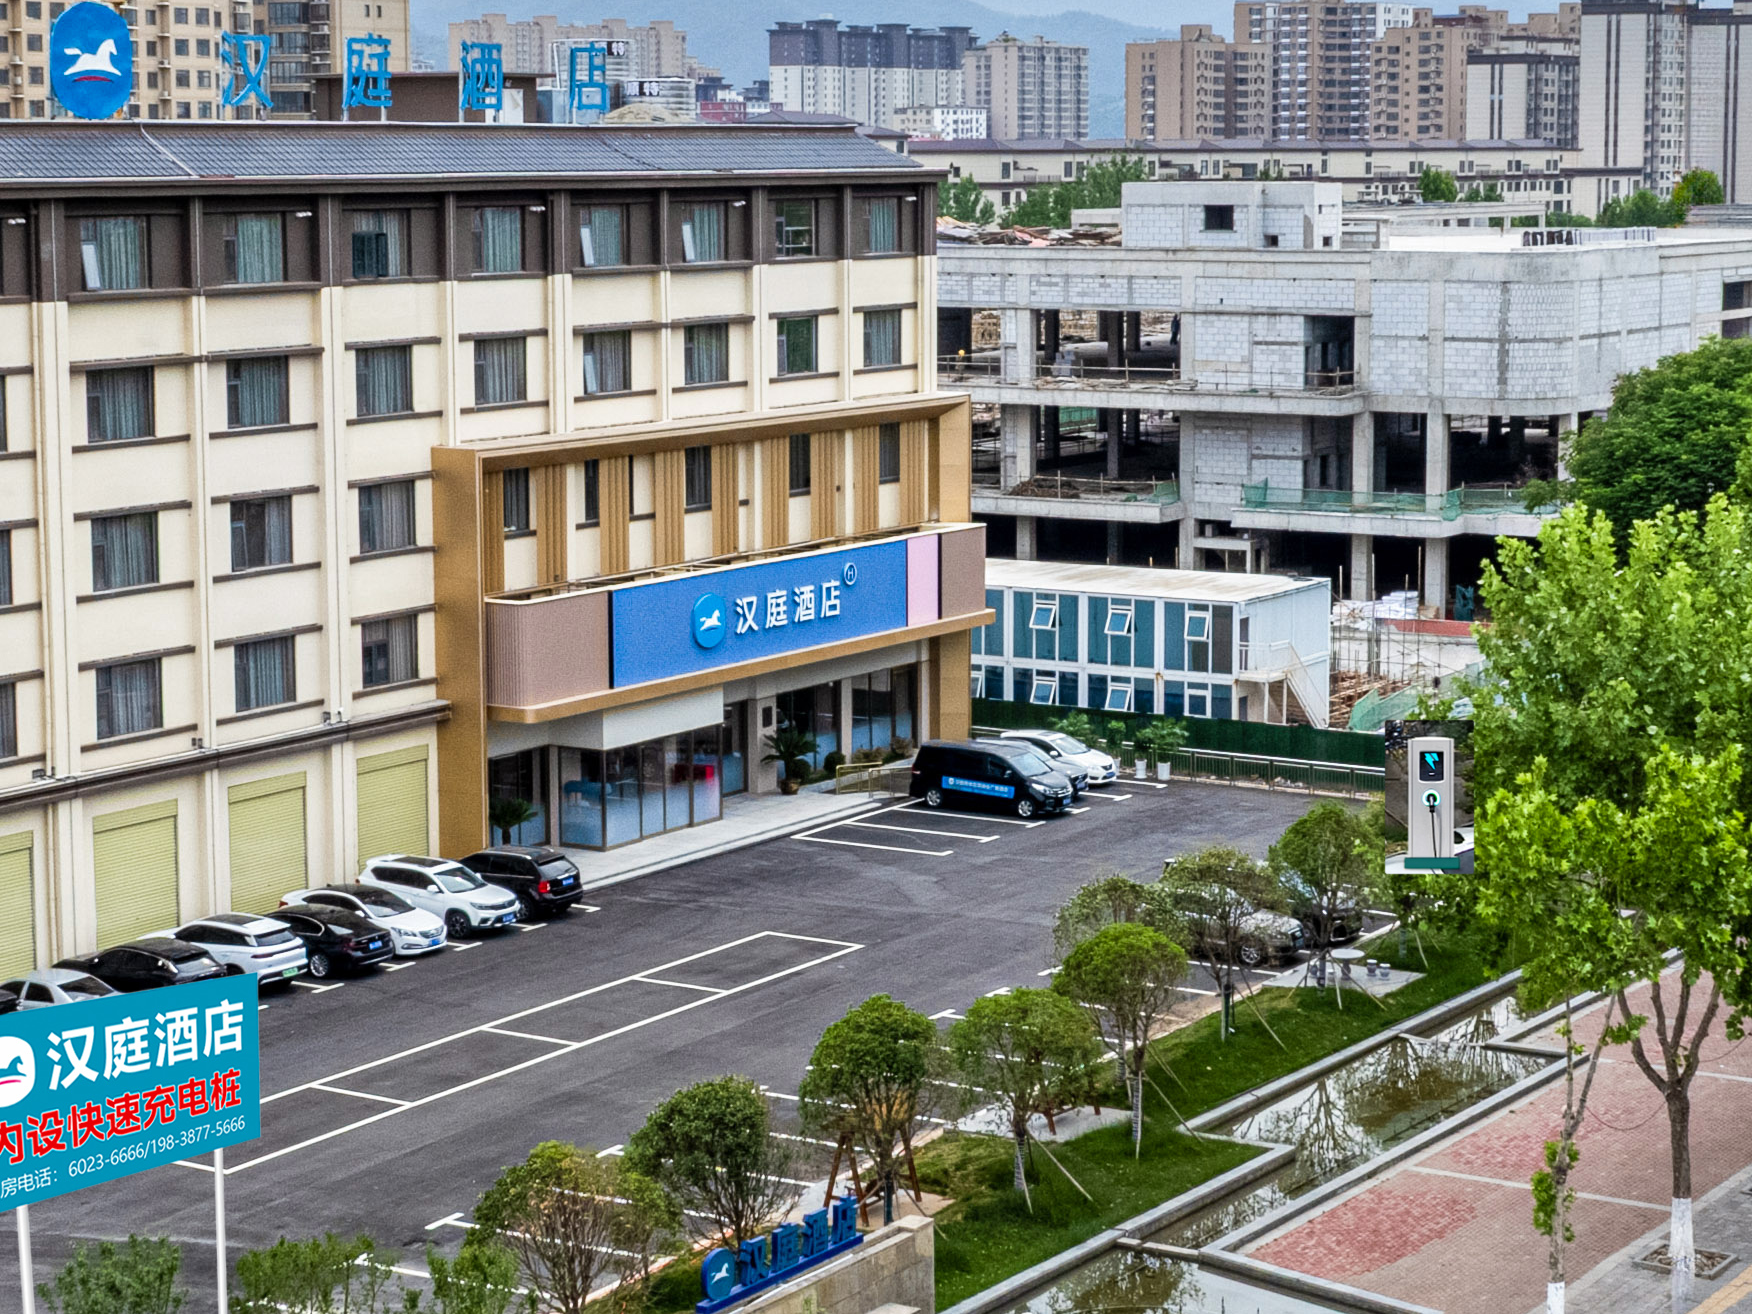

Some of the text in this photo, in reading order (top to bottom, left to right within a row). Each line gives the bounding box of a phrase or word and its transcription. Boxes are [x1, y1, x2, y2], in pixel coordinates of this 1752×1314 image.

[221, 30, 610, 111] 汉庭酒店
[734, 579, 841, 635] 汉庭酒店
[47, 999, 245, 1091] 汉庭酒店
[68, 1115, 246, 1177] 6023-6666/198-3877-5666
[739, 1194, 859, 1286] 汉庭酒店
